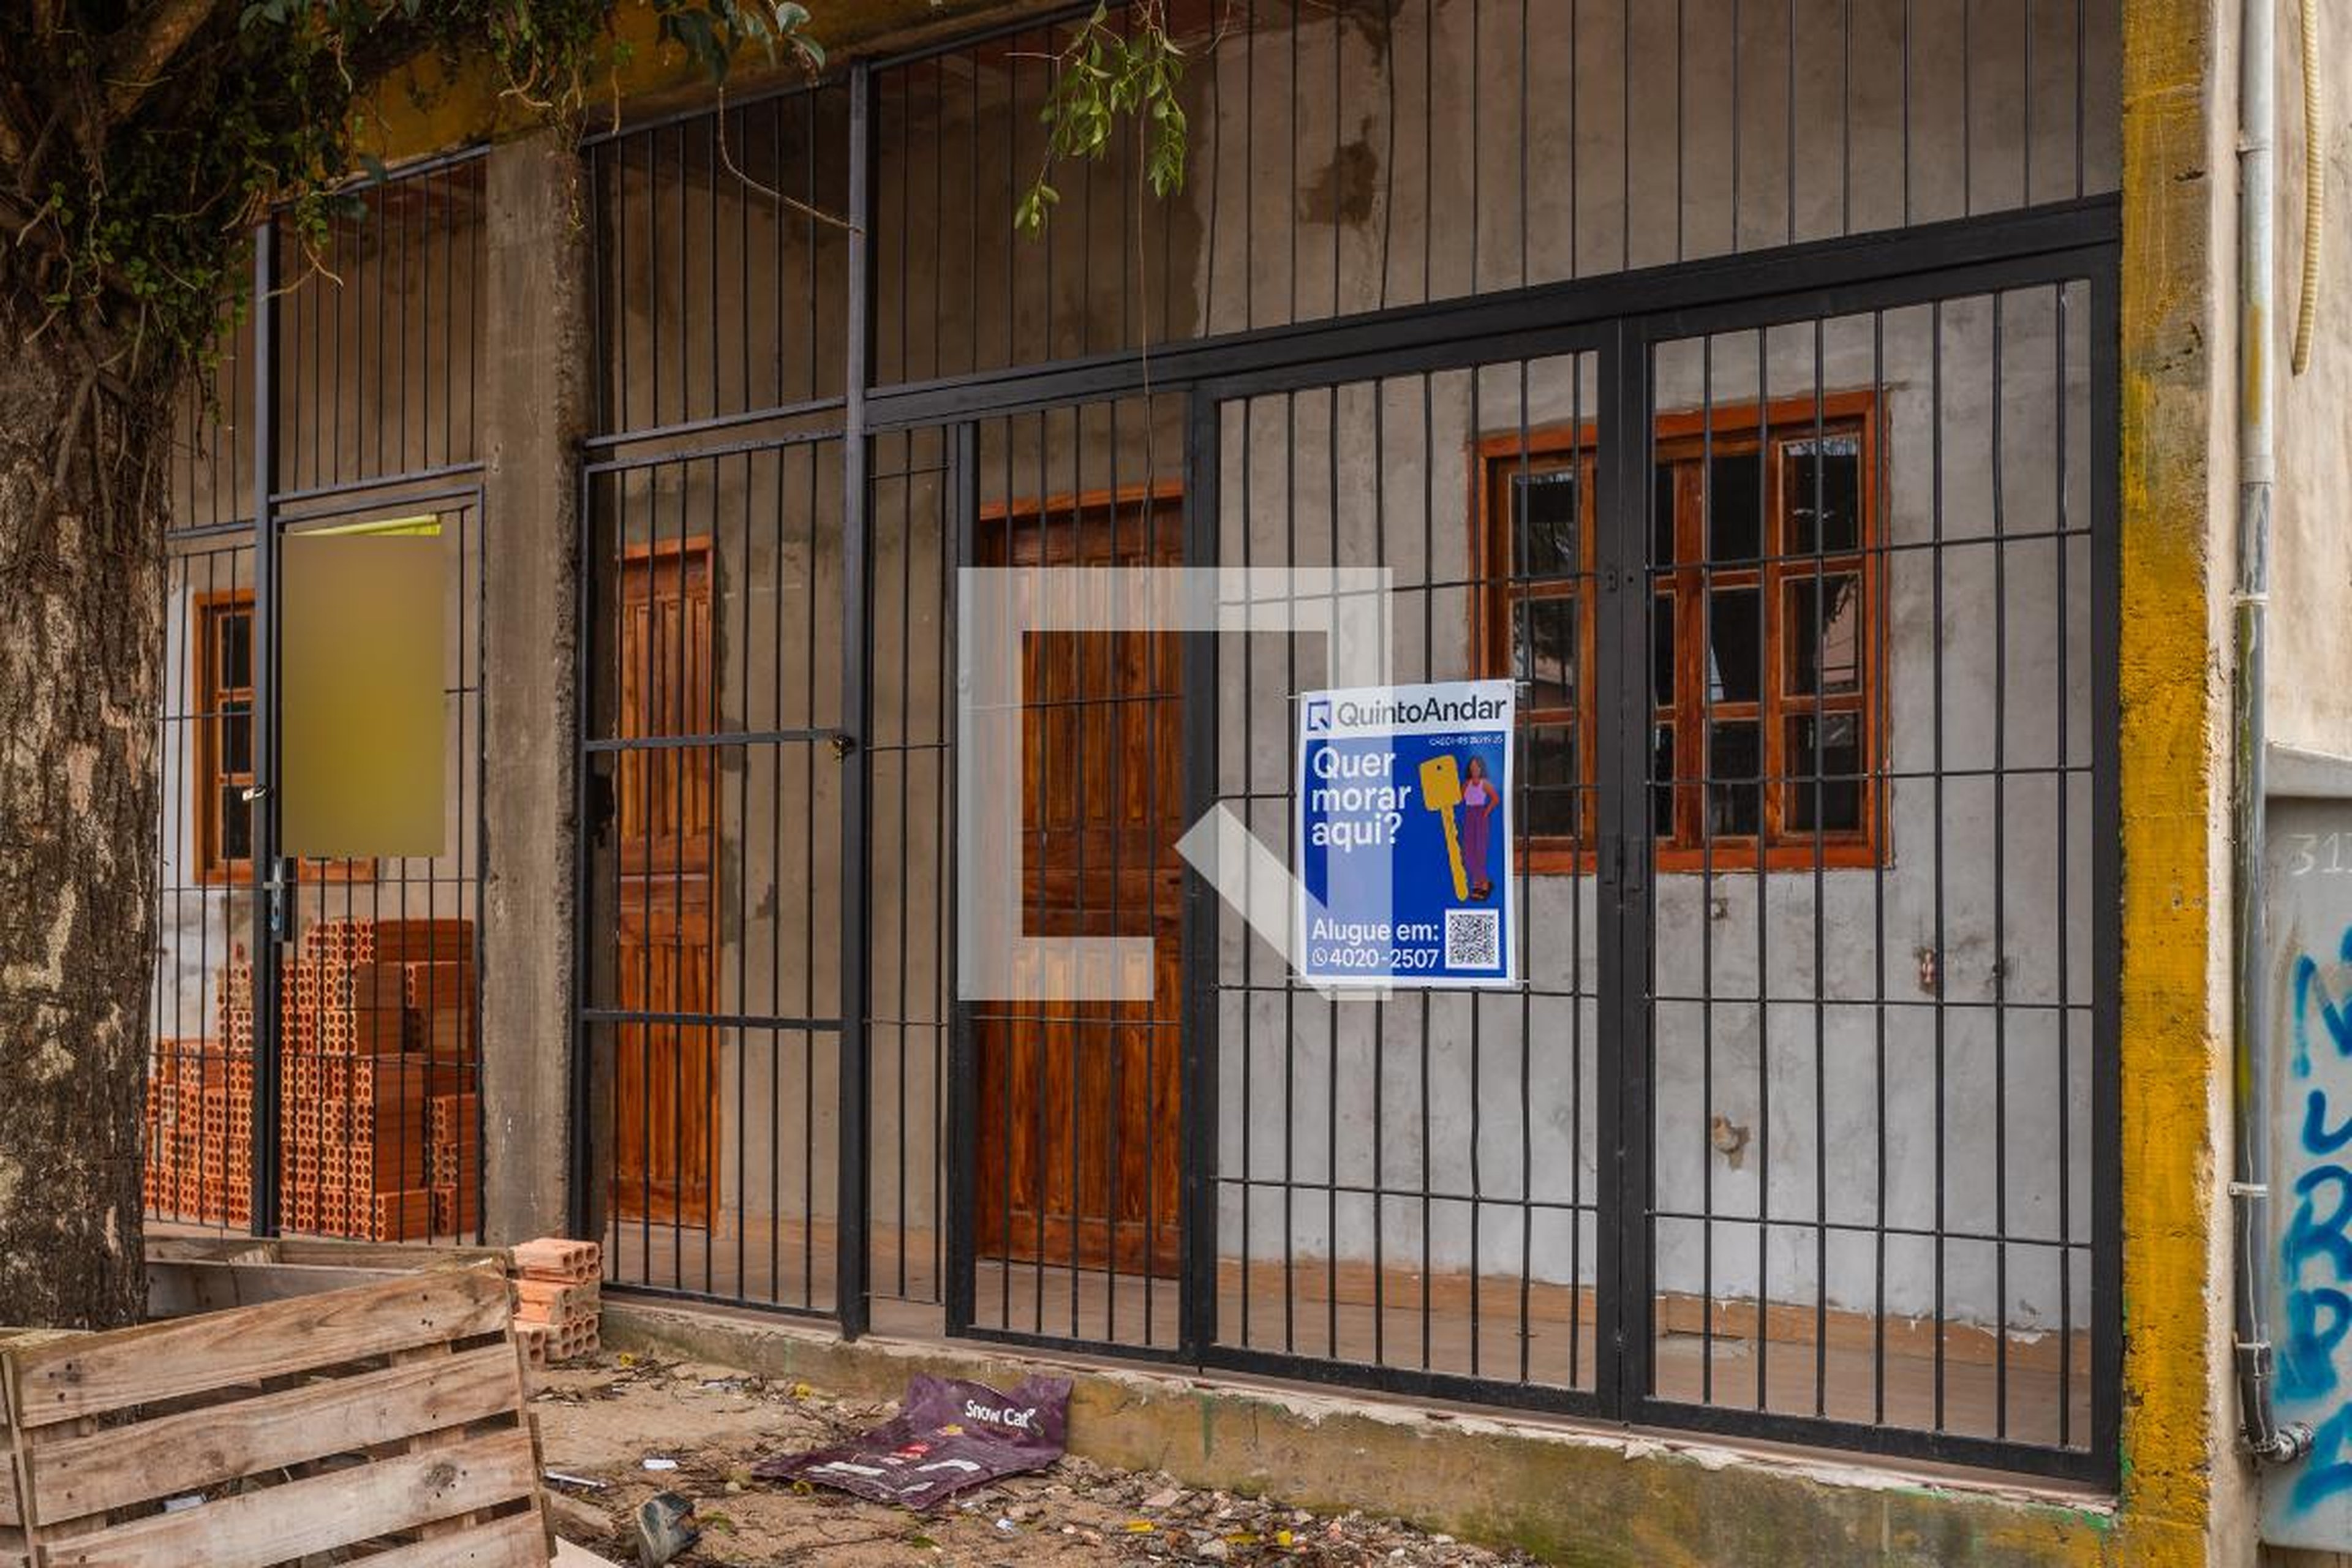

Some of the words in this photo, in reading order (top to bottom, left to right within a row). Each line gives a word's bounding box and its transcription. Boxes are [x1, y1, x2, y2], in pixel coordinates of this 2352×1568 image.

[1338, 694, 1507, 727] QuintoAndar
[1313, 746, 1396, 779] Quer
[1312, 786, 1412, 812] morar
[1311, 812, 1403, 853] aqui?
[1312, 918, 1391, 946] Alugue
[1396, 924, 1439, 941] em:
[1329, 948, 1439, 968] 4020-2507
[965, 1400, 1001, 1423] Snow
[1003, 1408, 1030, 1428] Cat
